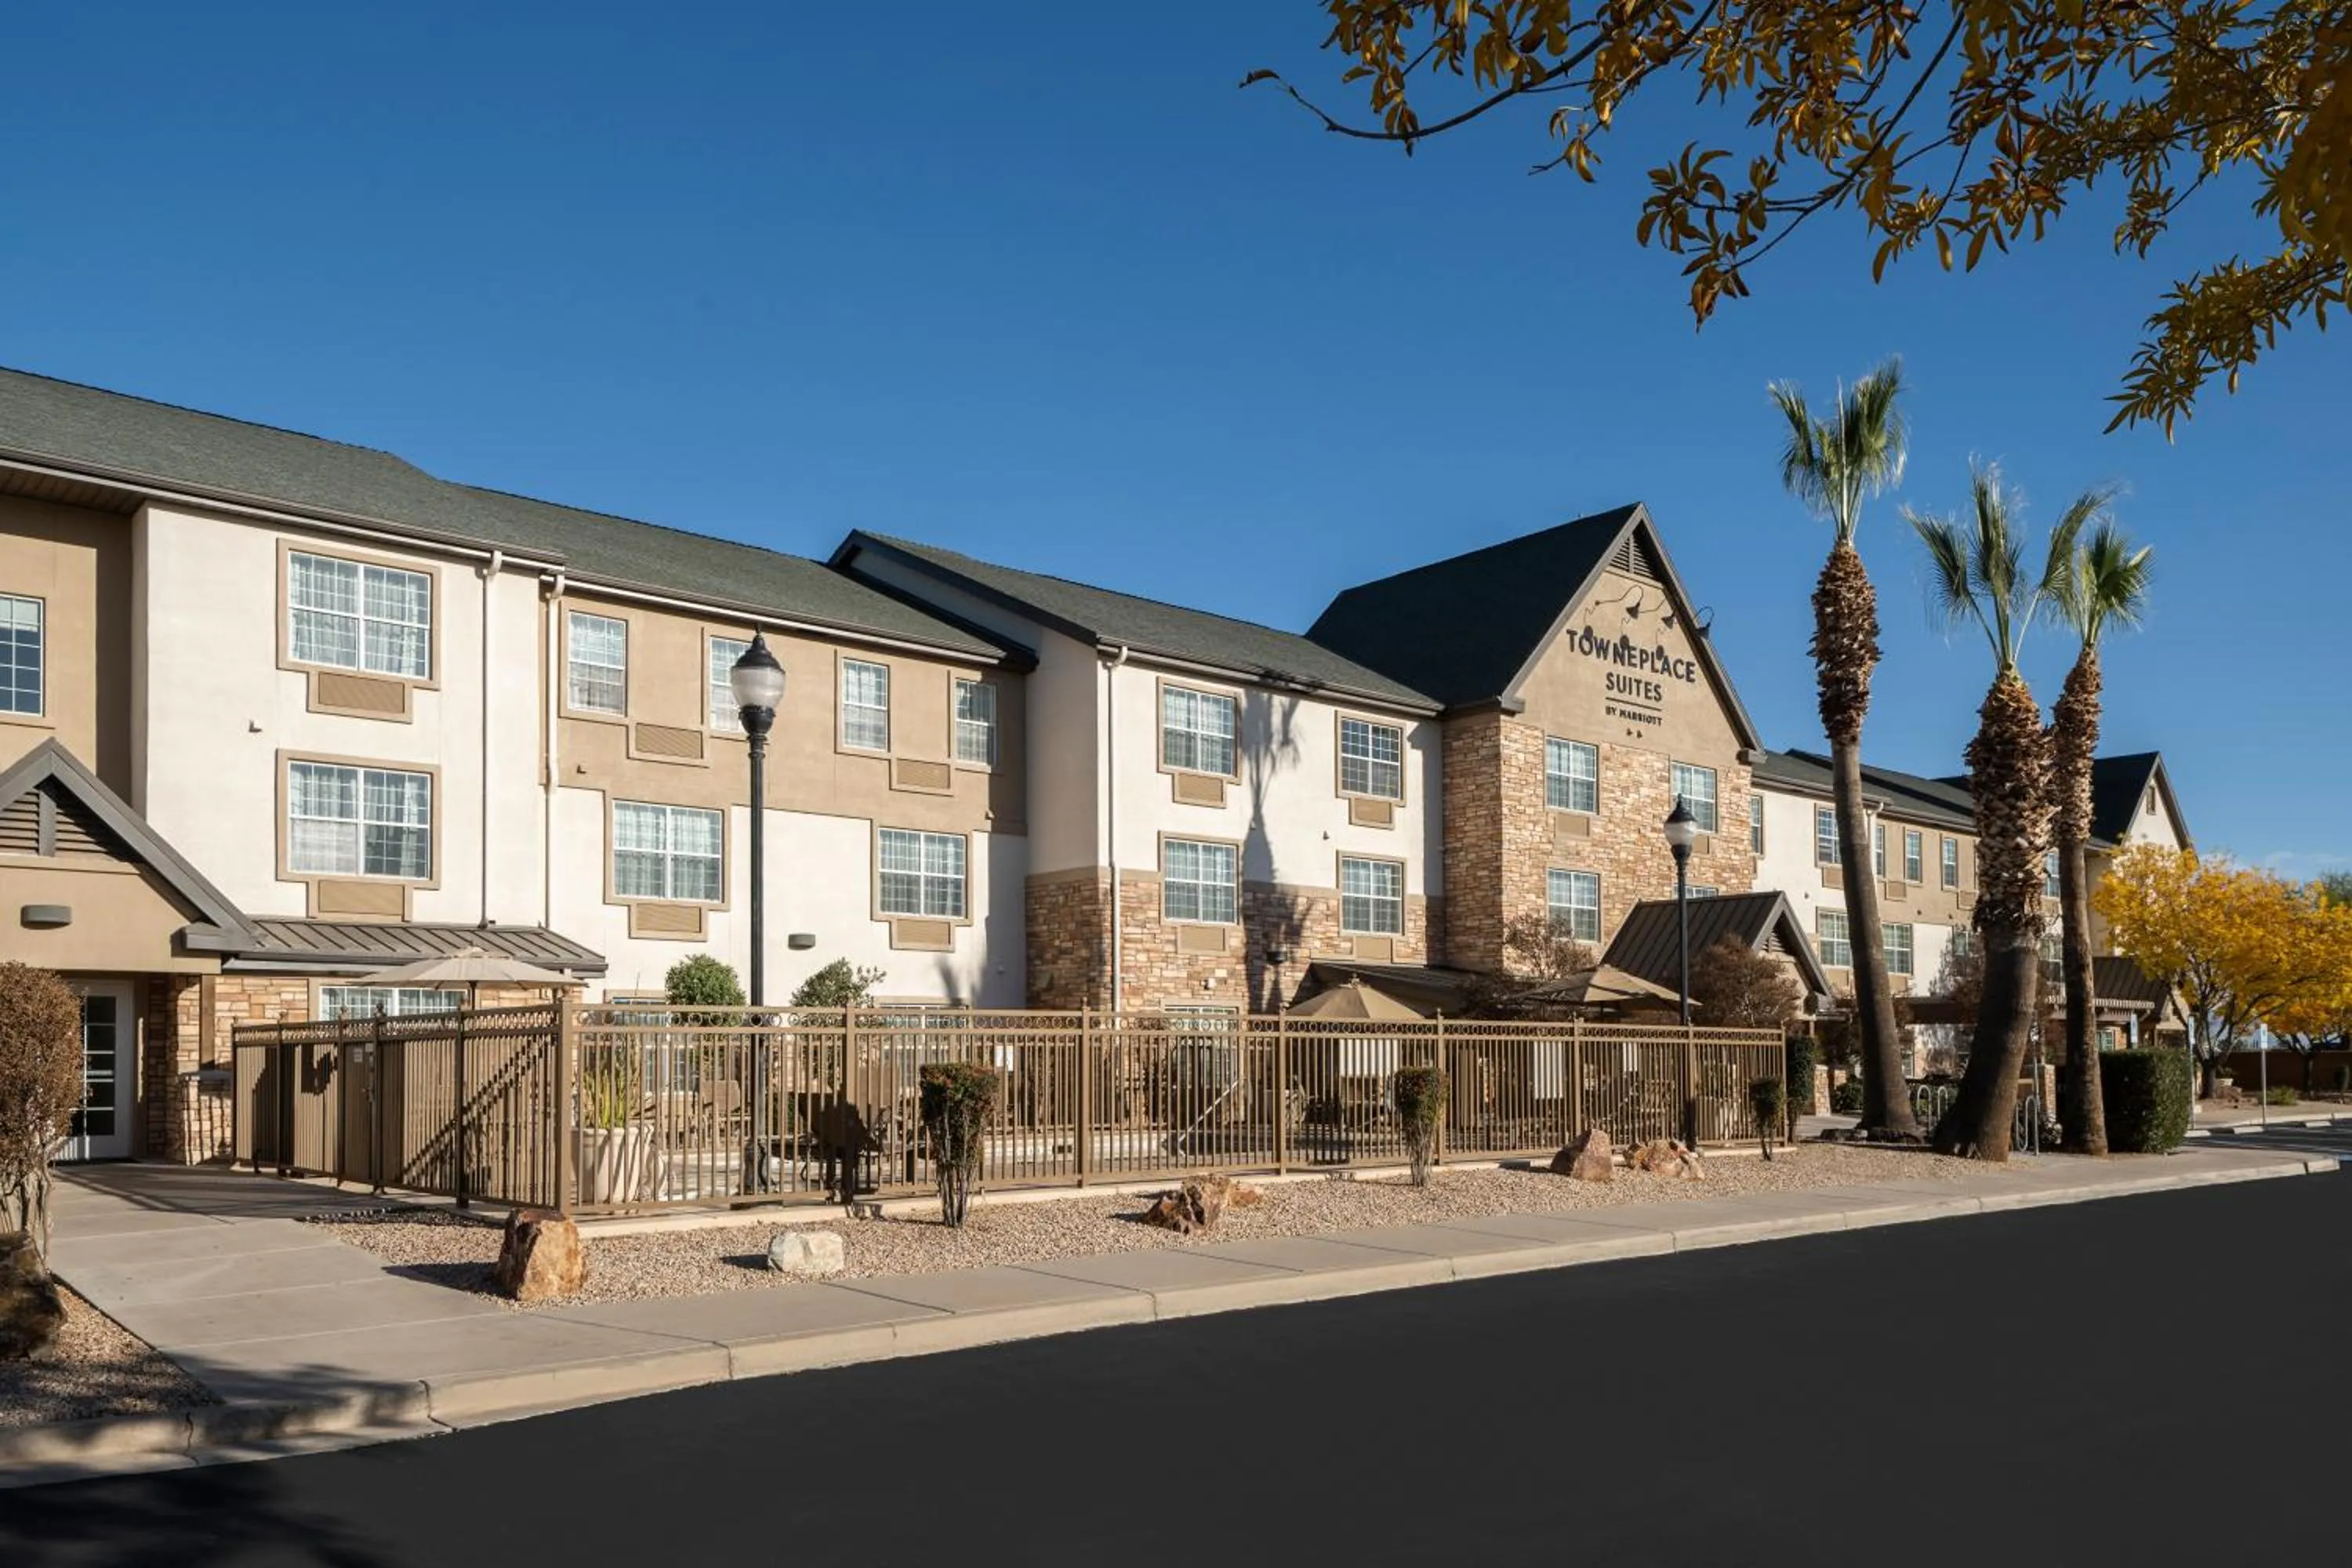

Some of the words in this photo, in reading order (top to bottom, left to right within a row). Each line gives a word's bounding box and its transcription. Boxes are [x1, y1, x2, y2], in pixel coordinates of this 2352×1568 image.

[1566, 629, 1696, 683] TOWNEPLACE
[1606, 672, 1662, 702] SUITES
[1605, 706, 1617, 715] BY
[1619, 709, 1663, 726] MARRIOTT
